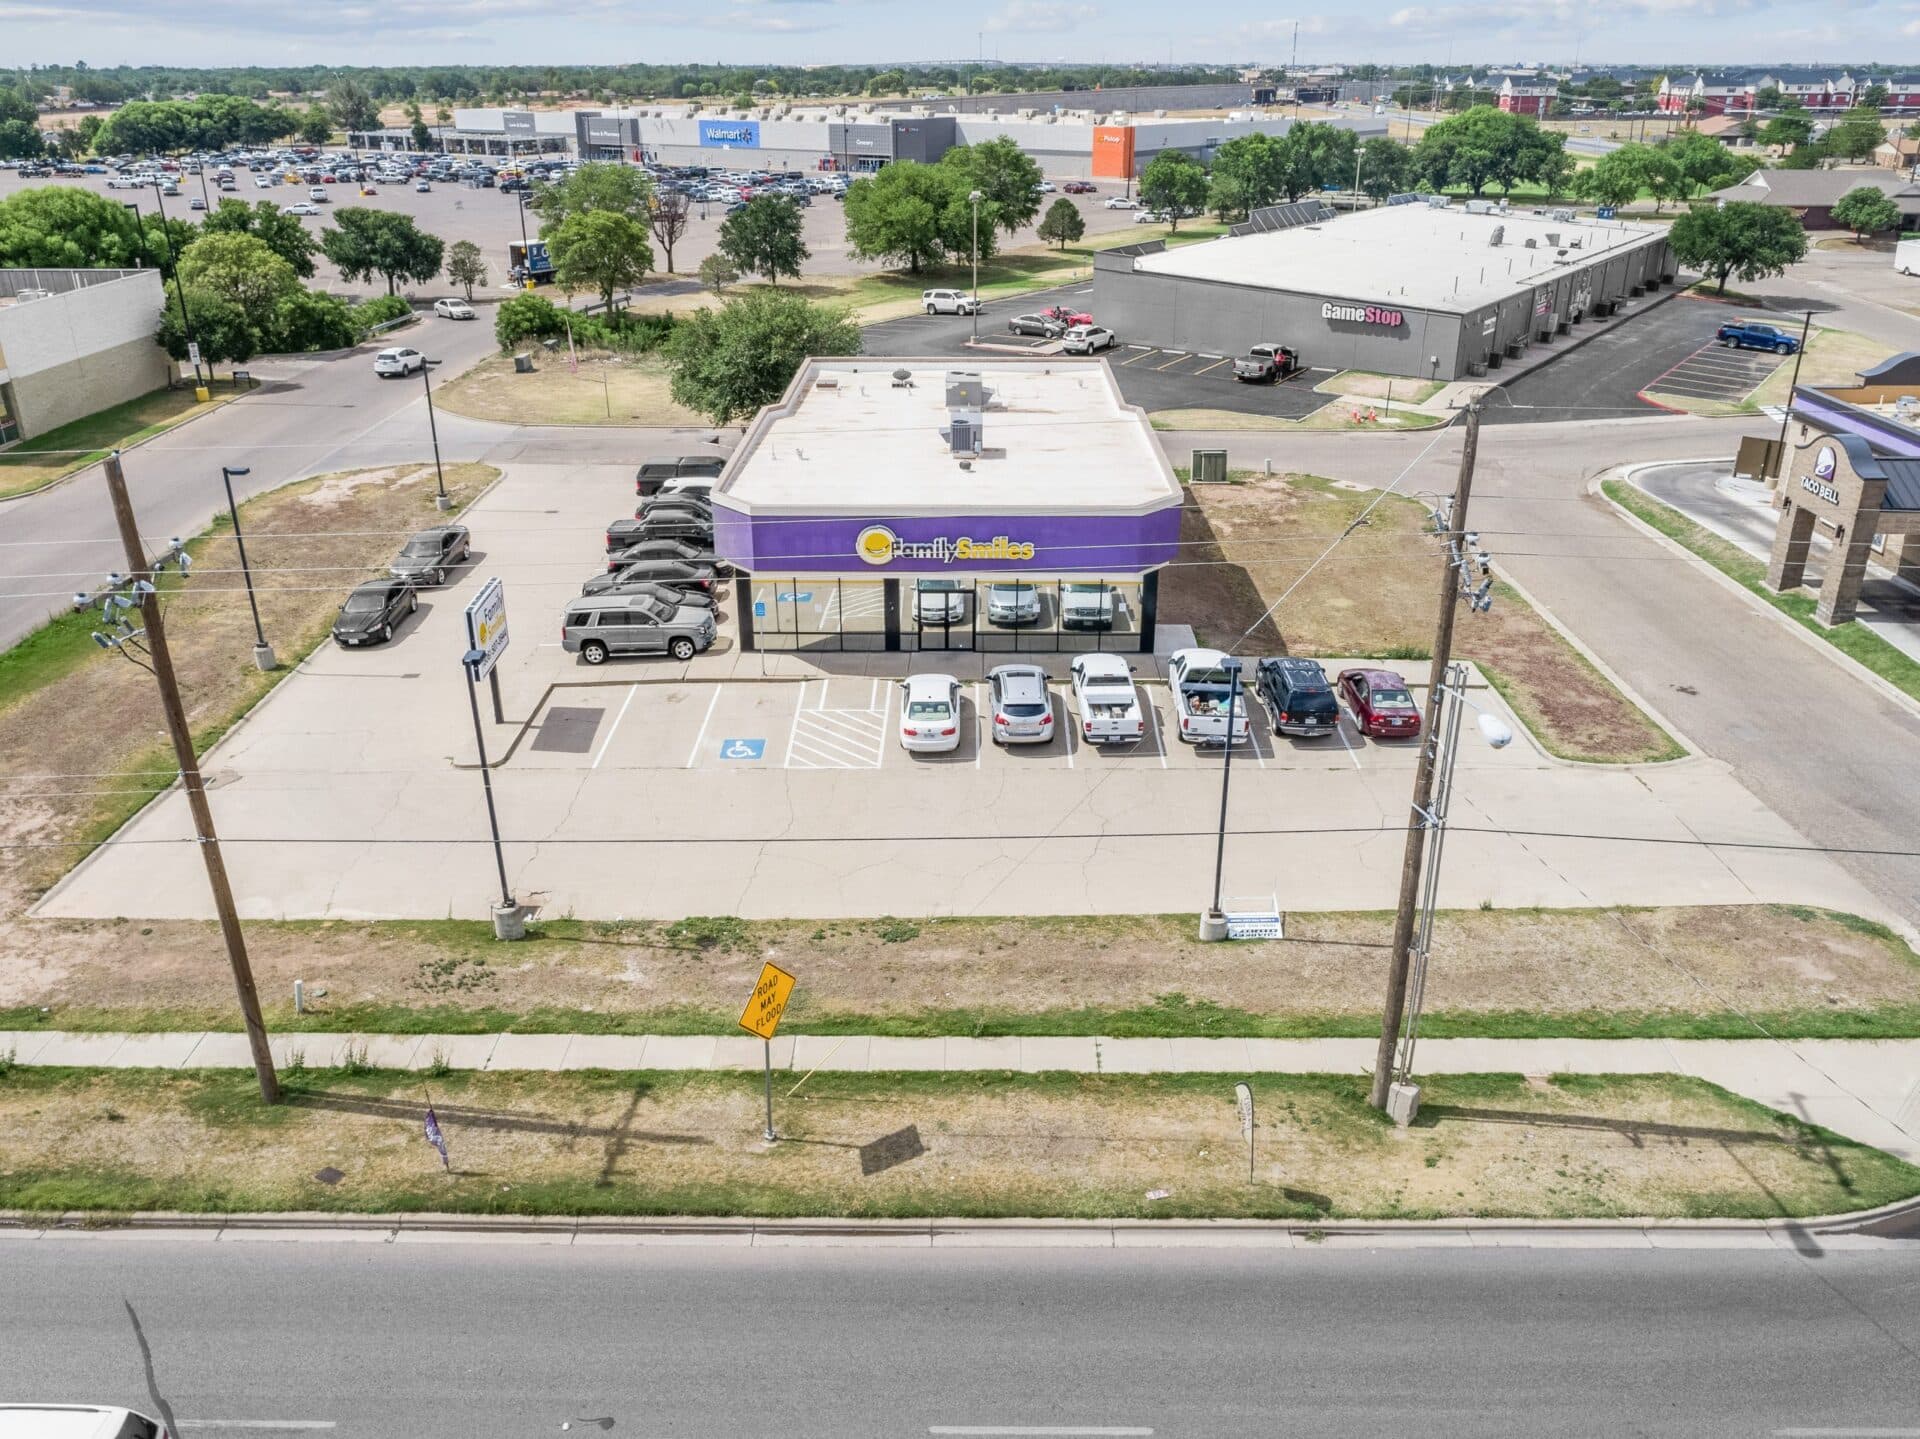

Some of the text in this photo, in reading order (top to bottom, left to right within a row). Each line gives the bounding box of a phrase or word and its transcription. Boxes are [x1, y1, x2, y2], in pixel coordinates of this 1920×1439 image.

[706, 128, 741, 140] Walmart
[1321, 302, 1402, 327] GameStop
[1801, 476, 1840, 505] TACO BELL
[757, 975, 778, 998] ROAD
[760, 991, 776, 1012] MAY
[756, 1003, 781, 1030] FLOOD
